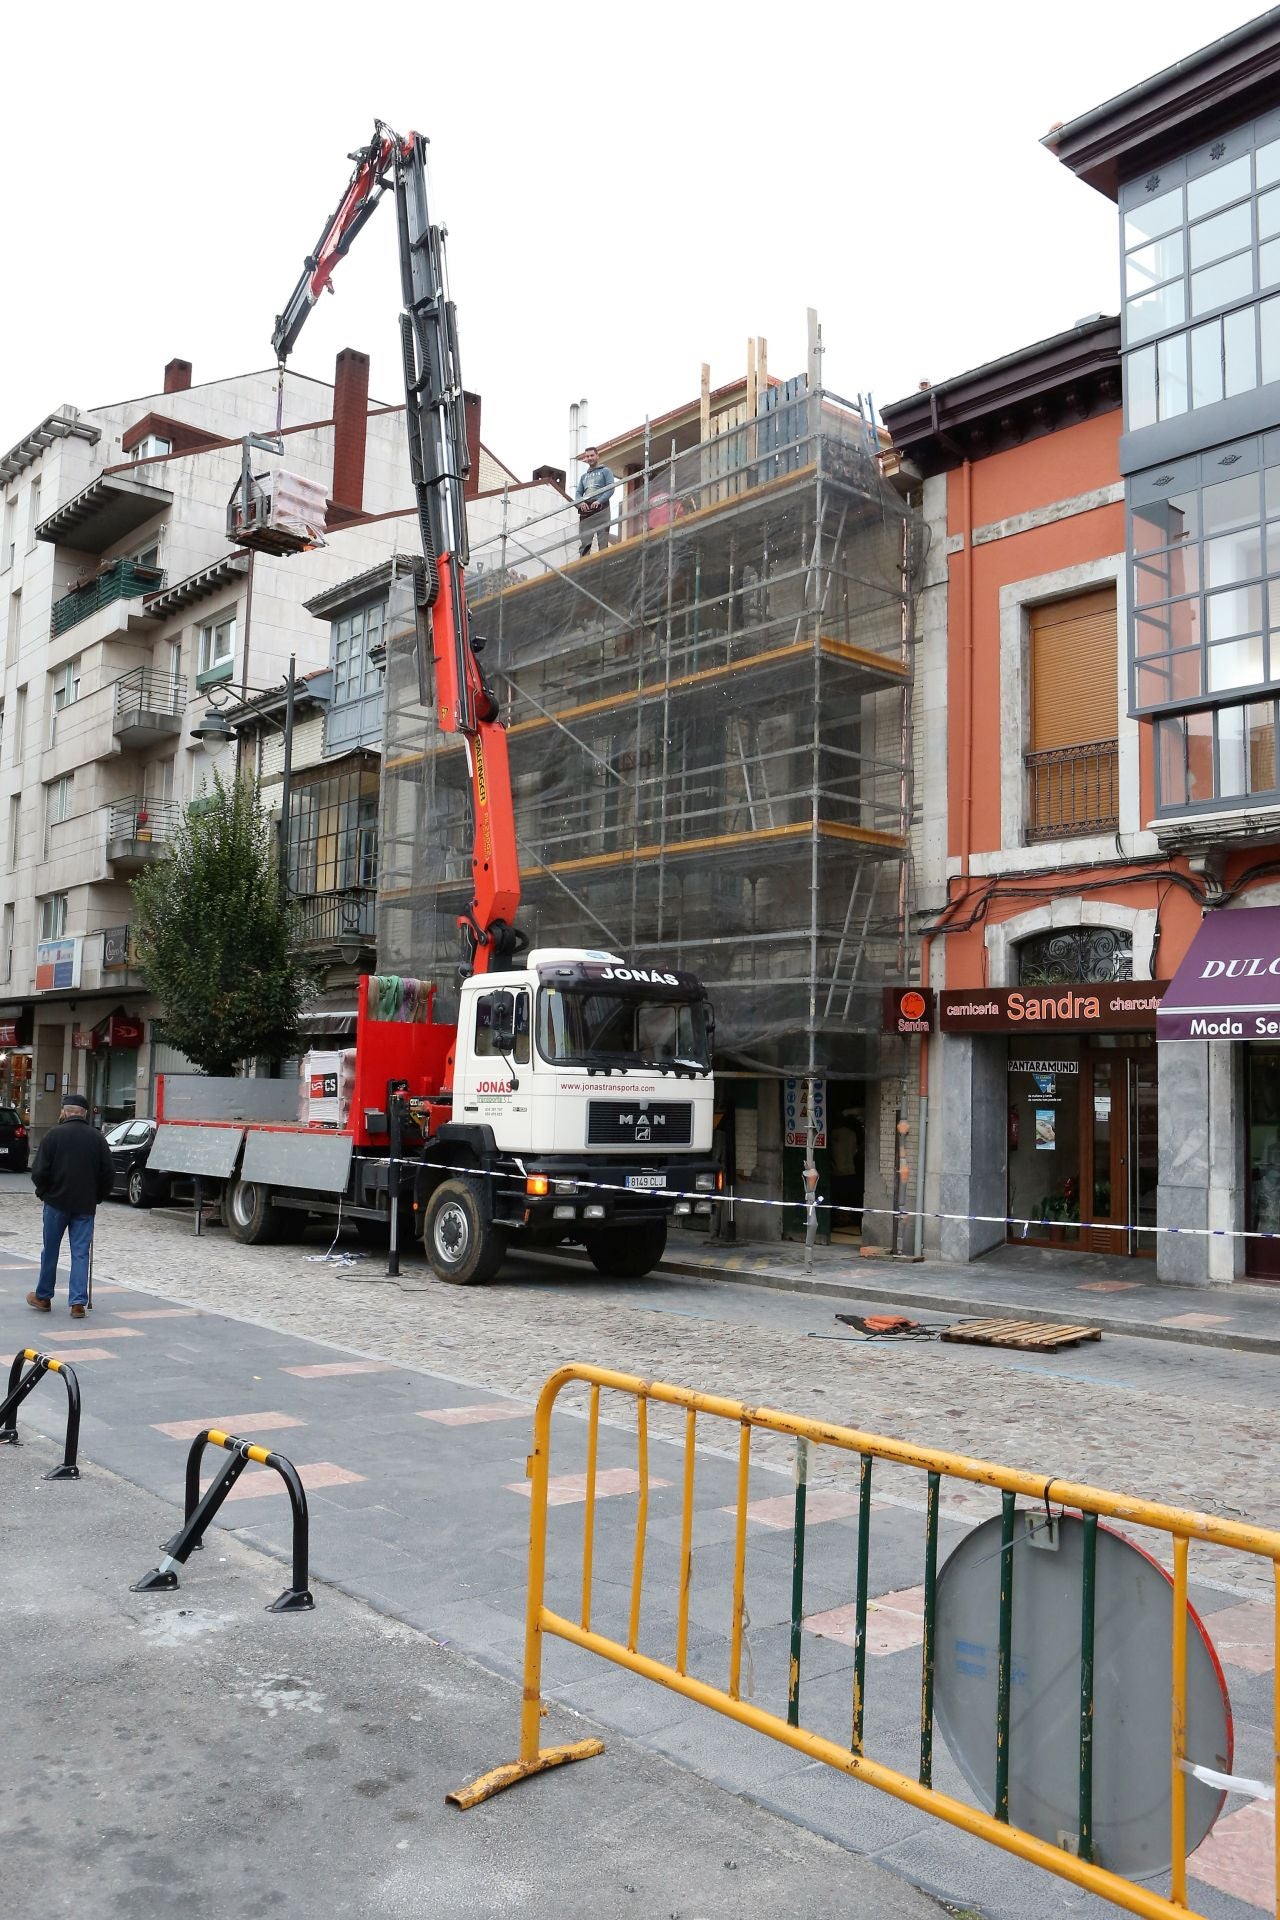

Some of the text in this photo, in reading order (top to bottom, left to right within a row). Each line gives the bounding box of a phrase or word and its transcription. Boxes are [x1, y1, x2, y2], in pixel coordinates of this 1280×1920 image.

[474, 739, 486, 802] PALFINGER
[601, 967, 680, 986] JONÁS
[946, 1002, 999, 1016] carnicería
[1006, 991, 1100, 1021] Sandra
[898, 1018, 929, 1032] Sandra
[1190, 1017, 1280, 1035] Moda Se
[1008, 1061, 1078, 1073] PANTARAMUNDI
[324, 1078, 336, 1092] CS
[476, 1078, 513, 1093] JONÁS
[560, 1082, 656, 1093] www.jonastransporta.com
[619, 1114, 666, 1125] MAN
[631, 1177, 664, 1187] 8149 CLJ
